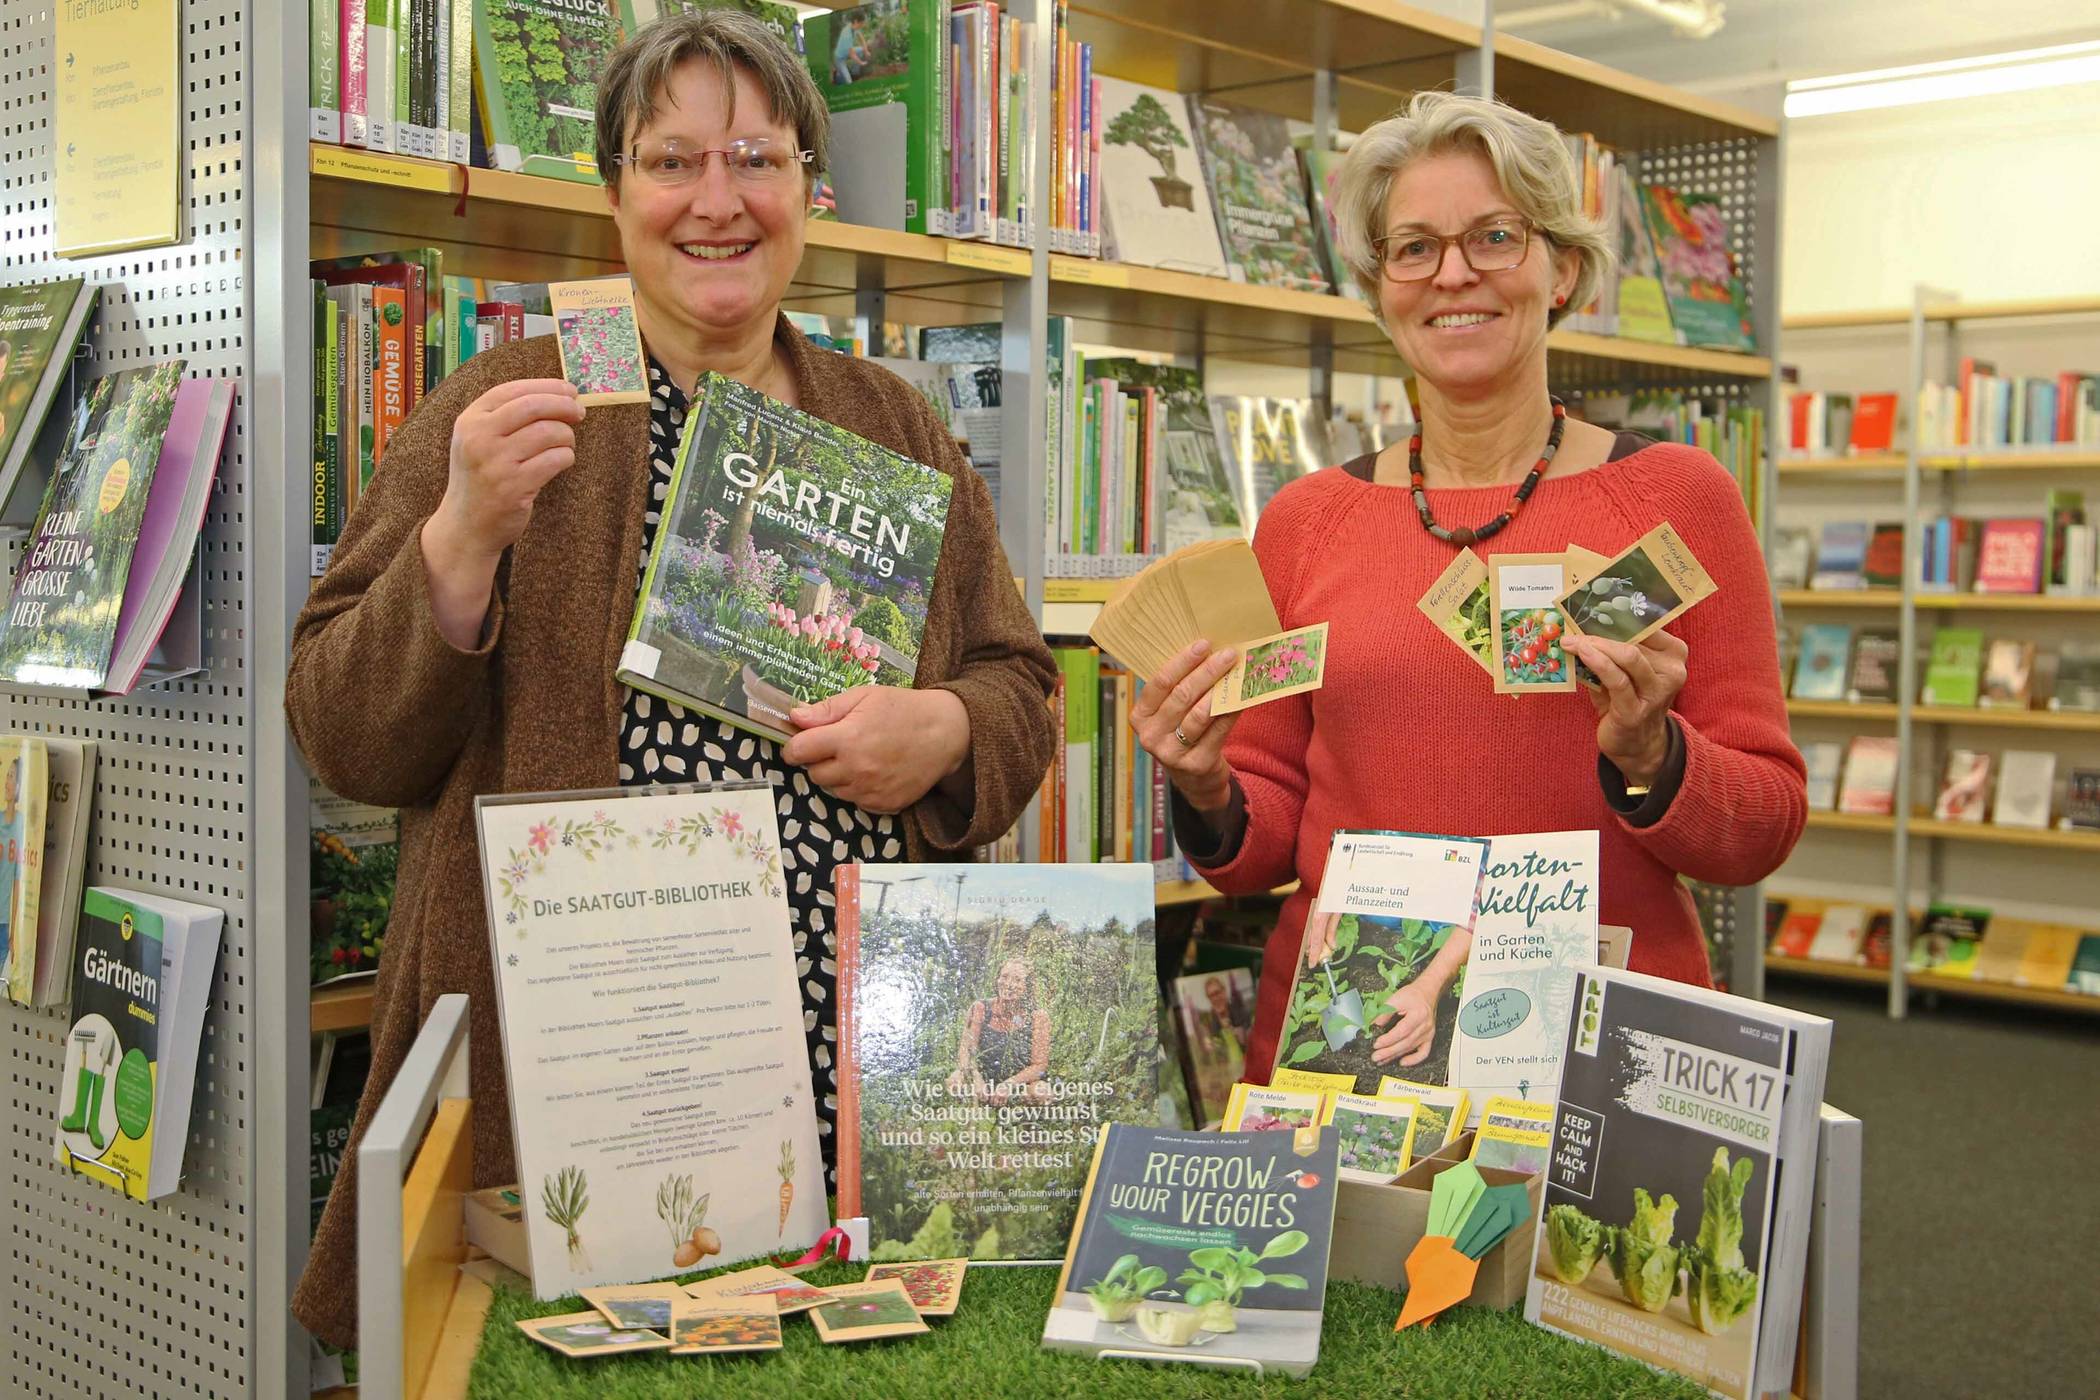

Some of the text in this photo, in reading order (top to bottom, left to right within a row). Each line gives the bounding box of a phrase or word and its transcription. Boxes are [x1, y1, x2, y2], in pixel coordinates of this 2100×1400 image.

[505, 1, 605, 28] AUCH OHNE GARTEN
[320, 56, 333, 110] TRICK
[1230, 219, 1280, 241] Pflanzen
[1, 301, 48, 318] Typgerechtes
[339, 322, 347, 386] Kisten-Gärtnern
[329, 346, 337, 428] Gemüsegarten
[384, 339, 401, 417] GEMÜSE
[724, 400, 742, 412] Fotos
[744, 410, 755, 419] von
[757, 416, 779, 429] Marion
[726, 392, 757, 411] Manfred
[757, 407, 784, 423] Lucenz
[792, 422, 813, 436] Klaus
[813, 431, 840, 447] Bender
[315, 461, 326, 525] INDOOR
[841, 478, 867, 501] Ein
[722, 451, 913, 558] GARTEN
[41, 510, 85, 537] KLEINE
[722, 485, 897, 579] ist niemals fertig
[21, 569, 72, 597] GROSSE
[1508, 584, 1554, 593] Wilde Tomaten
[11, 601, 49, 628] LIEBE
[703, 631, 847, 692] einem immerblühenden Garte
[715, 622, 847, 682] Ideen und Erfahrungen aus
[747, 697, 791, 721] Bassermann
[1458, 856, 1472, 864] BZL
[1485, 851, 1583, 879] orten-
[534, 880, 753, 918] Die SAATGUT-BIBLIOTHEK
[1347, 883, 1410, 897] Aussaat- und
[1345, 895, 1404, 909] Pflanzzeiten
[1480, 934, 1545, 946] in Garten
[1480, 946, 1553, 961] und Küche
[84, 947, 157, 1005] Gärtnern
[592, 990, 605, 998] Wie
[607, 984, 645, 996] funktioniert
[658, 976, 720, 990] Saatgut-Bibliothek?
[128, 999, 156, 1026] dummies
[1473, 993, 1507, 1012] Saatgut
[1488, 1009, 1500, 1019] ist
[1580, 978, 1601, 1047] TOPP
[1476, 1012, 1521, 1036] Kulturgut
[1740, 1025, 1760, 1038] MARCO
[1476, 1057, 1493, 1065] Der
[1495, 1056, 1514, 1065] VEN
[1517, 1056, 1538, 1064] stellt
[901, 1077, 1114, 1101] Wie du dein eigenes
[1393, 1083, 1432, 1096] Färberwaid
[1663, 1047, 1775, 1111] TRICK 17
[1249, 1090, 1287, 1101] Rote Melde
[1338, 1095, 1377, 1108] Brandkraut
[911, 1103, 1100, 1126] Saatgut gewinnst
[1564, 1112, 1591, 1131] KEEP
[1657, 1094, 1770, 1142] SELBSTVERSORGER
[881, 1125, 1101, 1146] und so ein kleines St
[1560, 1127, 1592, 1148] CALM
[946, 1150, 1074, 1170] Welt rettest
[1564, 1142, 1583, 1157] AND
[1144, 1151, 1276, 1190] REGROW
[1556, 1152, 1588, 1173] HACK
[1562, 1168, 1576, 1184] IT!
[914, 1188, 1078, 1200] alte Sorten erhalten, Pflanzenvielfalt
[1110, 1183, 1298, 1228] YOUR VEGGIES
[974, 1203, 1049, 1213] unabhängig sein
[1130, 1231, 1232, 1245] nachwachsen lassen
[1131, 1224, 1233, 1239] Gemüsereste endlos
[1544, 1281, 1686, 1347] 222 GENIALE LIFEHACKS RUND
[1541, 1301, 1599, 1331] ANPFLANZEN,
[1600, 1320, 1636, 1343] ERNTEN
[1637, 1333, 1658, 1352] UND
